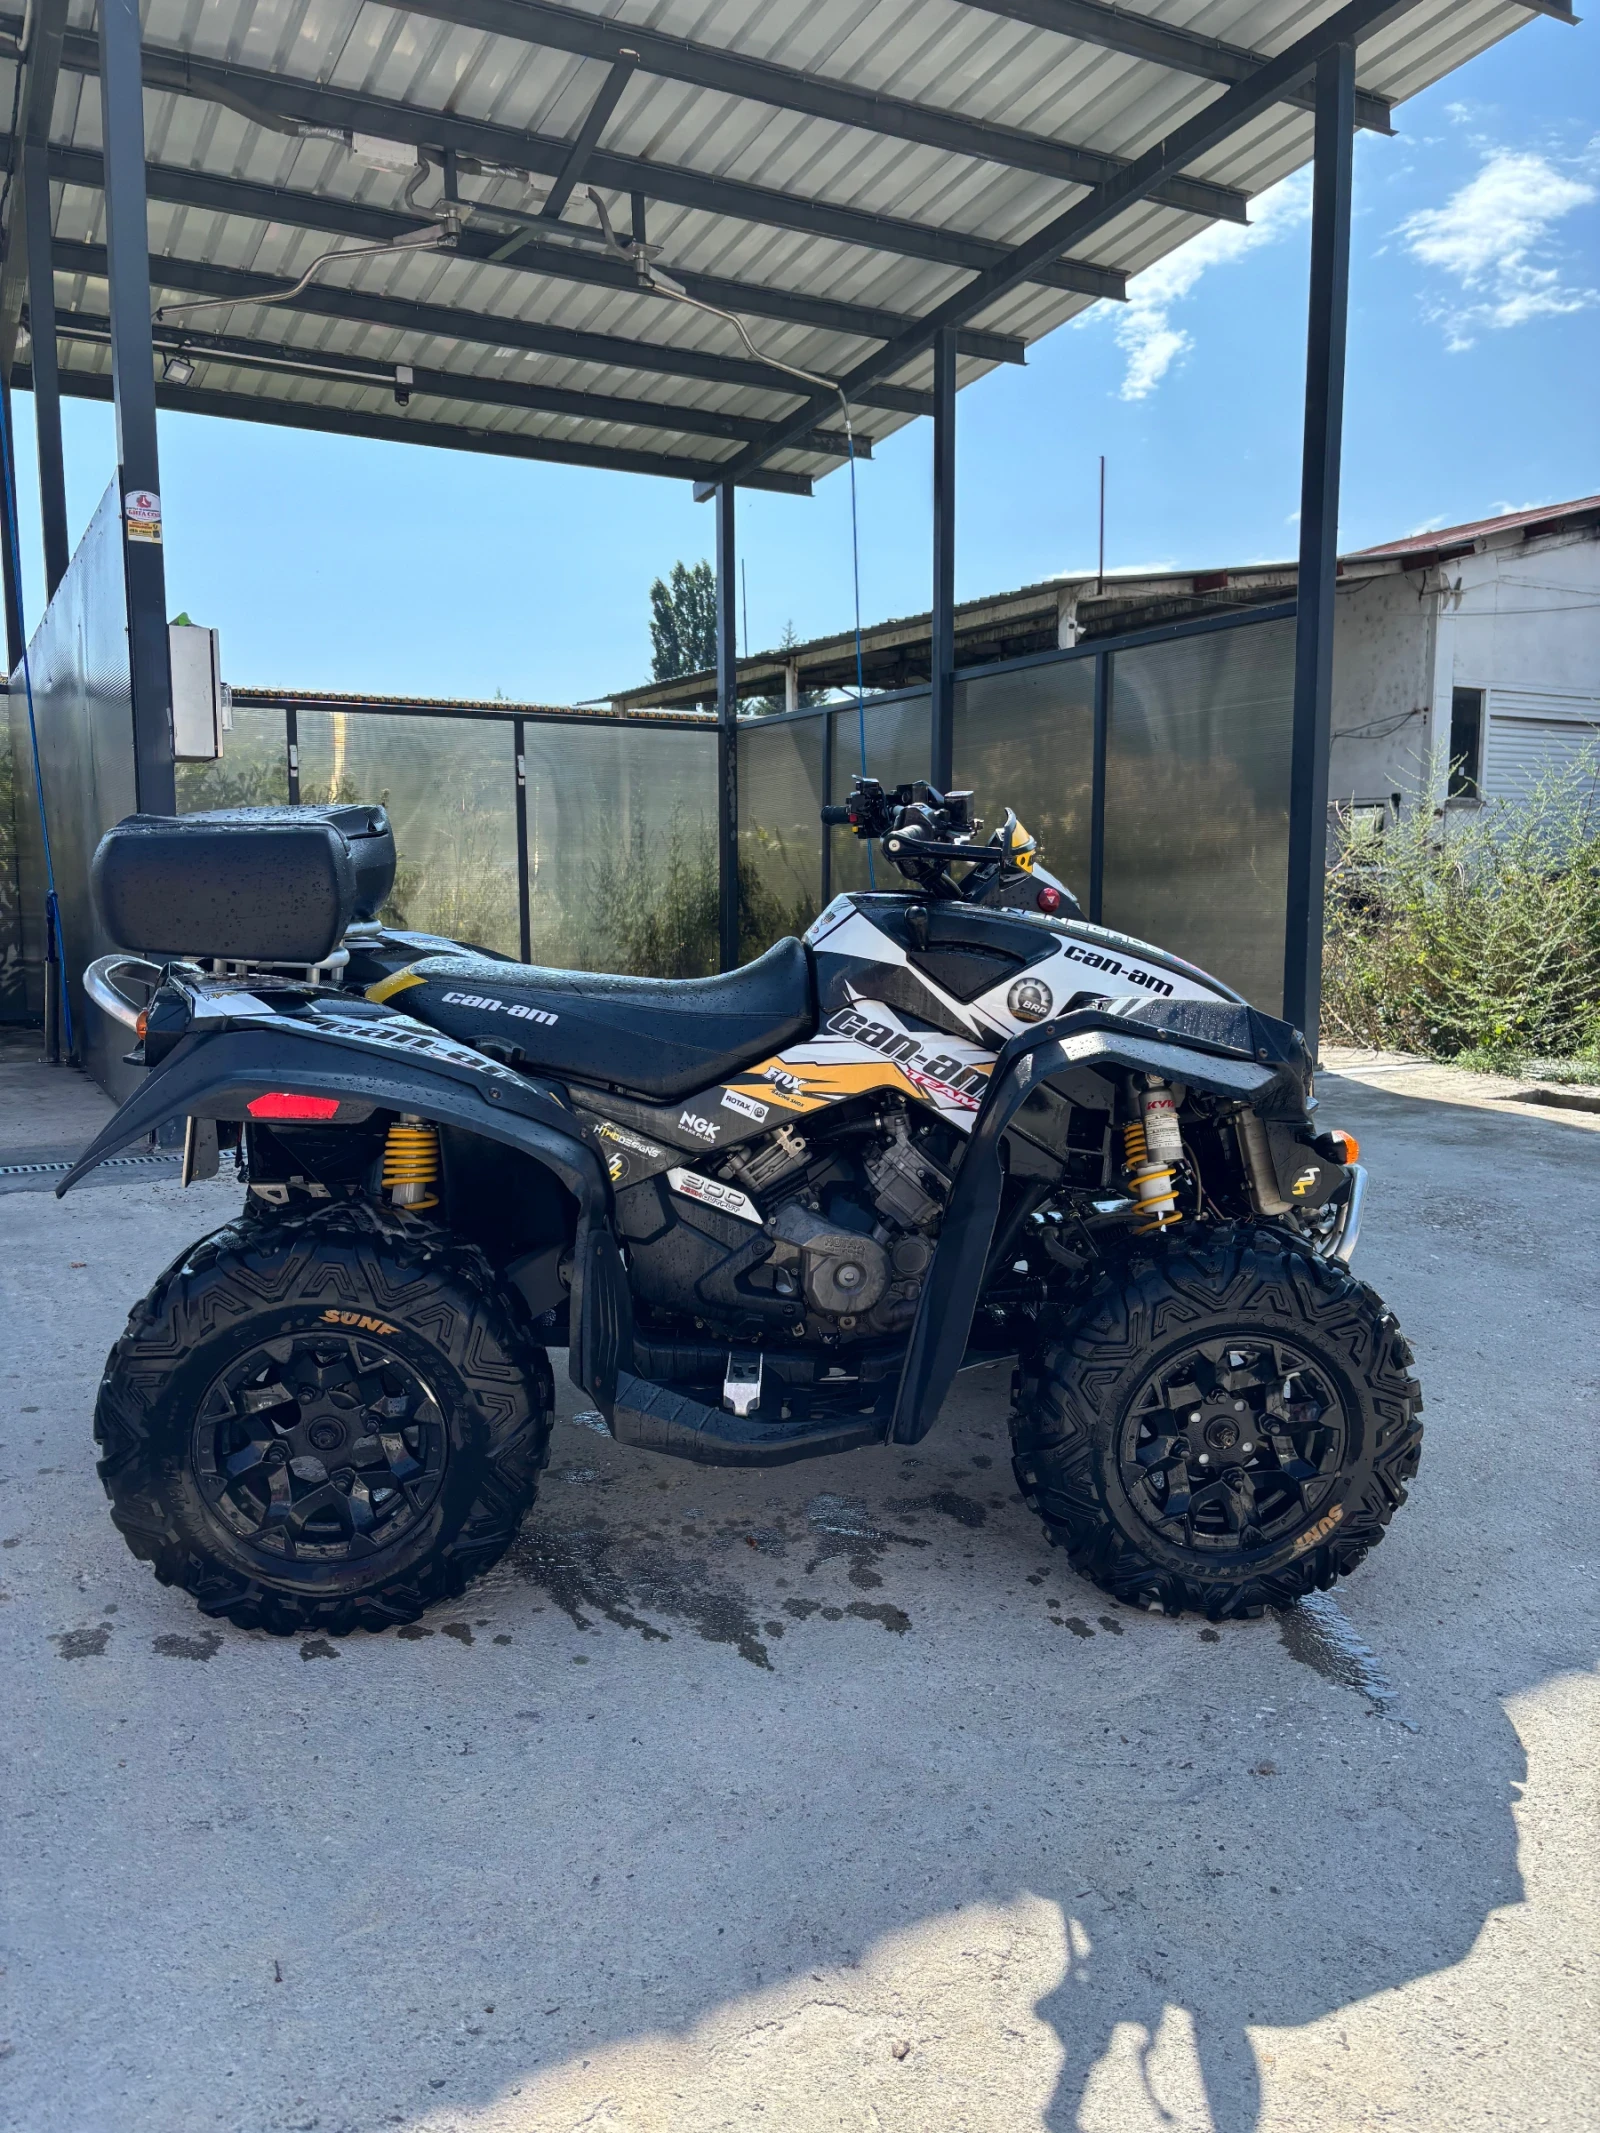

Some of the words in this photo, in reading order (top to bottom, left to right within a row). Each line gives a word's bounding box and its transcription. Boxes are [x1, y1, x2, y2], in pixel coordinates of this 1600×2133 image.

[1063, 945, 1175, 997] can-am
[441, 991, 559, 1026] can-am
[1022, 1000, 1048, 1014] BRP
[762, 1065, 808, 1095] FOX
[725, 1095, 751, 1111] ROTAX
[677, 1123, 696, 1136] SPARK
[695, 1132, 715, 1144] PLUGS
[679, 1110, 721, 1139] NGK
